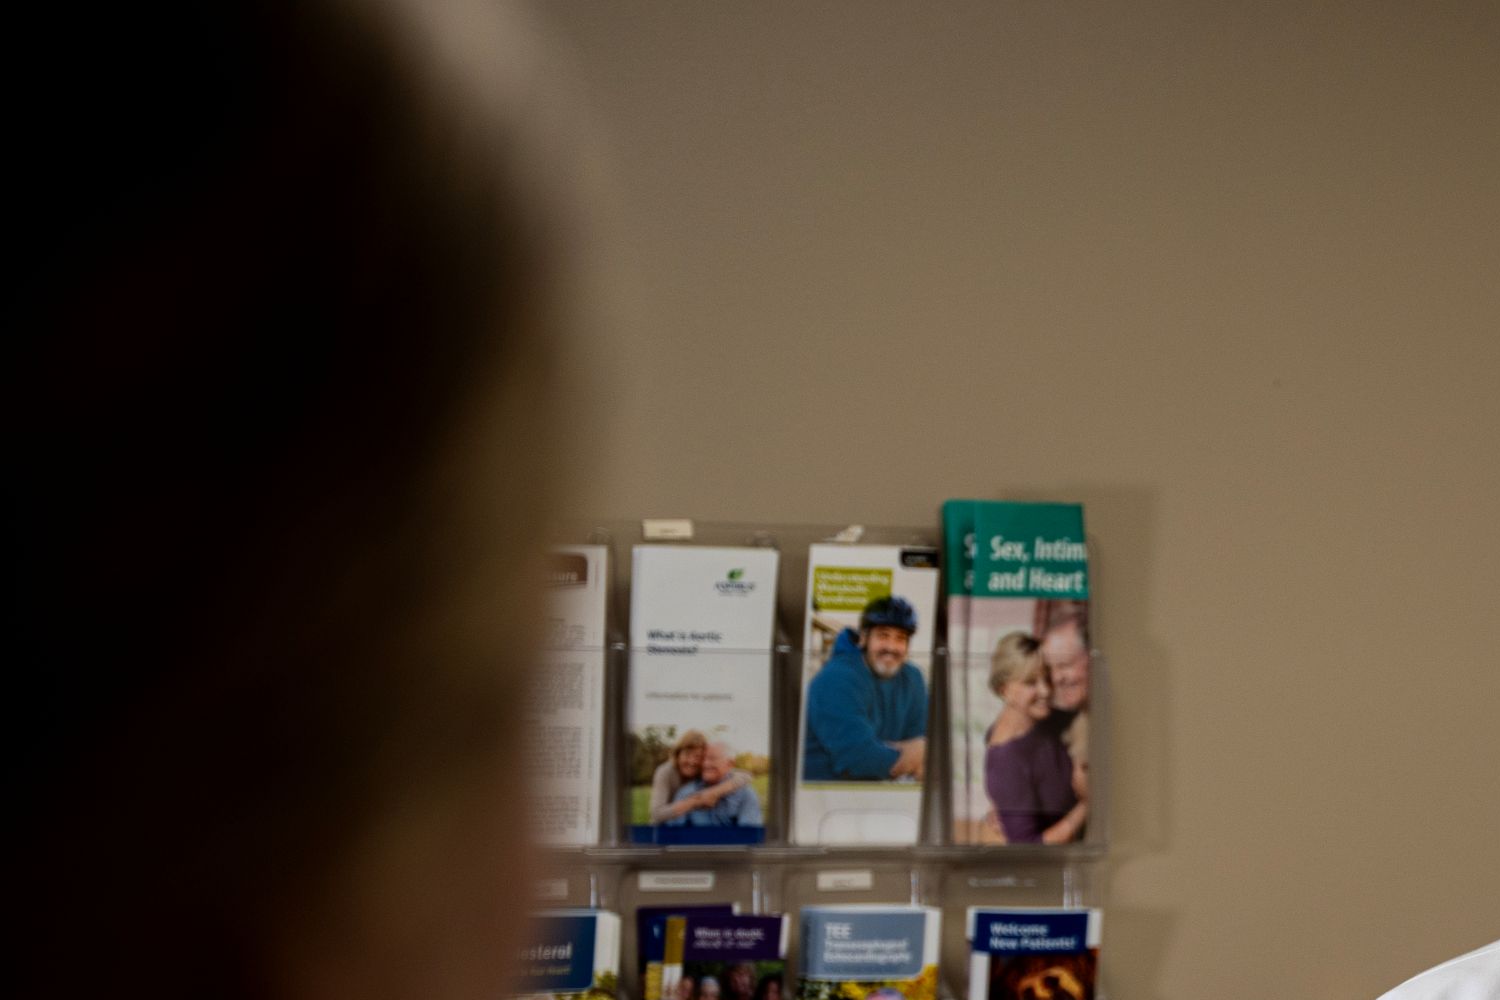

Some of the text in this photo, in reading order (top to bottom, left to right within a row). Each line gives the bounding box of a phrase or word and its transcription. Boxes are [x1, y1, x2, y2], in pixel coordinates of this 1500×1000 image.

[990, 534, 1030, 563] Sex,
[988, 567, 1085, 592] and Heart
[824, 922, 853, 939] TEE
[989, 921, 1049, 937] Welcome
[514, 942, 573, 961] lesterol
[989, 935, 1076, 951] New Patients!
